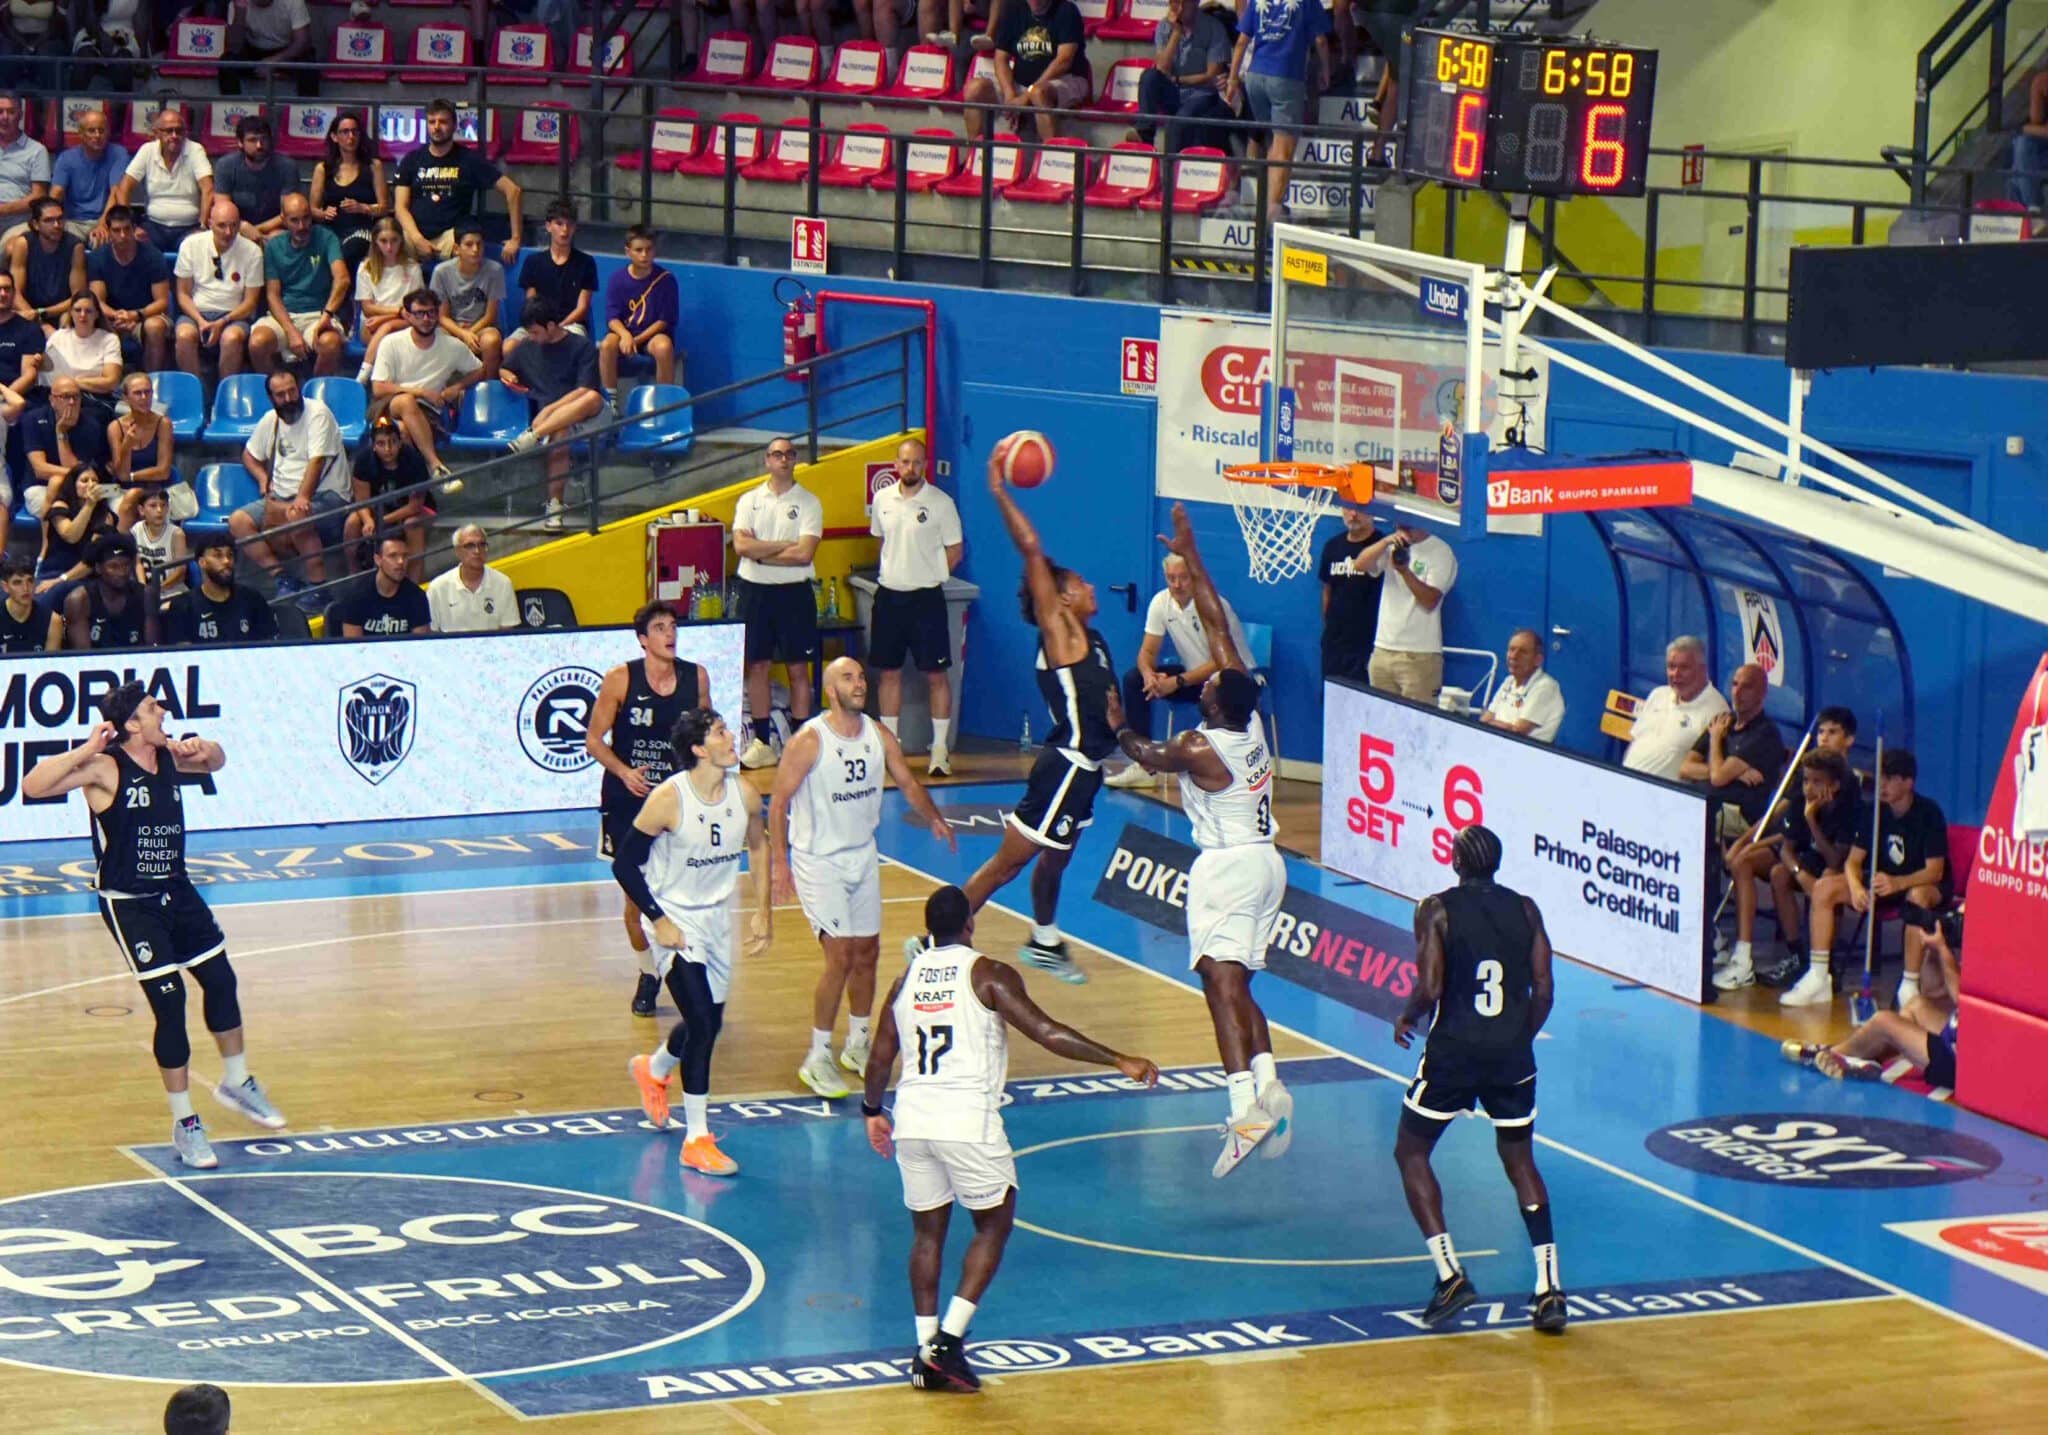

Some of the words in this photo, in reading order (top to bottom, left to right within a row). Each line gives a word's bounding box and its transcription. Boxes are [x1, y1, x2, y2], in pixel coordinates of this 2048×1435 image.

[1437, 38, 1488, 88] 6:58
[1544, 50, 1633, 96] 6:58
[1453, 94, 1483, 176] 6
[1582, 104, 1626, 186] 6
[1428, 282, 1459, 314] Unipol
[1510, 485, 1554, 504] Bank
[1558, 489, 1598, 500] GRUPPO
[1601, 485, 1658, 498] SPARKASSE
[199, 621, 218, 638] 45
[630, 707, 653, 727] 34
[632, 749, 661, 760] FRIULI
[633, 739, 646, 749] IO
[845, 759, 867, 783] 33
[1359, 733, 1395, 805] 5
[1443, 764, 1484, 829] 6
[126, 785, 150, 809] 26
[138, 826, 151, 836] IO
[154, 824, 181, 836] SONO
[710, 823, 721, 847] 6
[1347, 797, 1404, 847] SET
[137, 850, 178, 861] VENEZIA
[138, 838, 168, 849] FRIULI
[1582, 820, 1681, 874] Palasport
[137, 862, 172, 873] GIULIA
[1534, 834, 1592, 874] Primo
[1597, 856, 1680, 903] Carnera
[1978, 868, 2023, 893] GRUPPO
[1583, 881, 1680, 934] Credifriuli
[917, 965, 958, 983] FOSTER
[1474, 960, 1504, 1017] 3
[914, 990, 955, 1002] KRAFT
[915, 1024, 954, 1076] 17
[1668, 1126, 1830, 1181] ENERGY
[1731, 1121, 1937, 1173] SKY
[268, 1204, 640, 1259] BCC
[177, 1325, 370, 1351] GRUPPO
[404, 1313, 500, 1331] BCC
[508, 1299, 672, 1322] ICCREA
[1074, 1320, 1313, 1361] Bank
